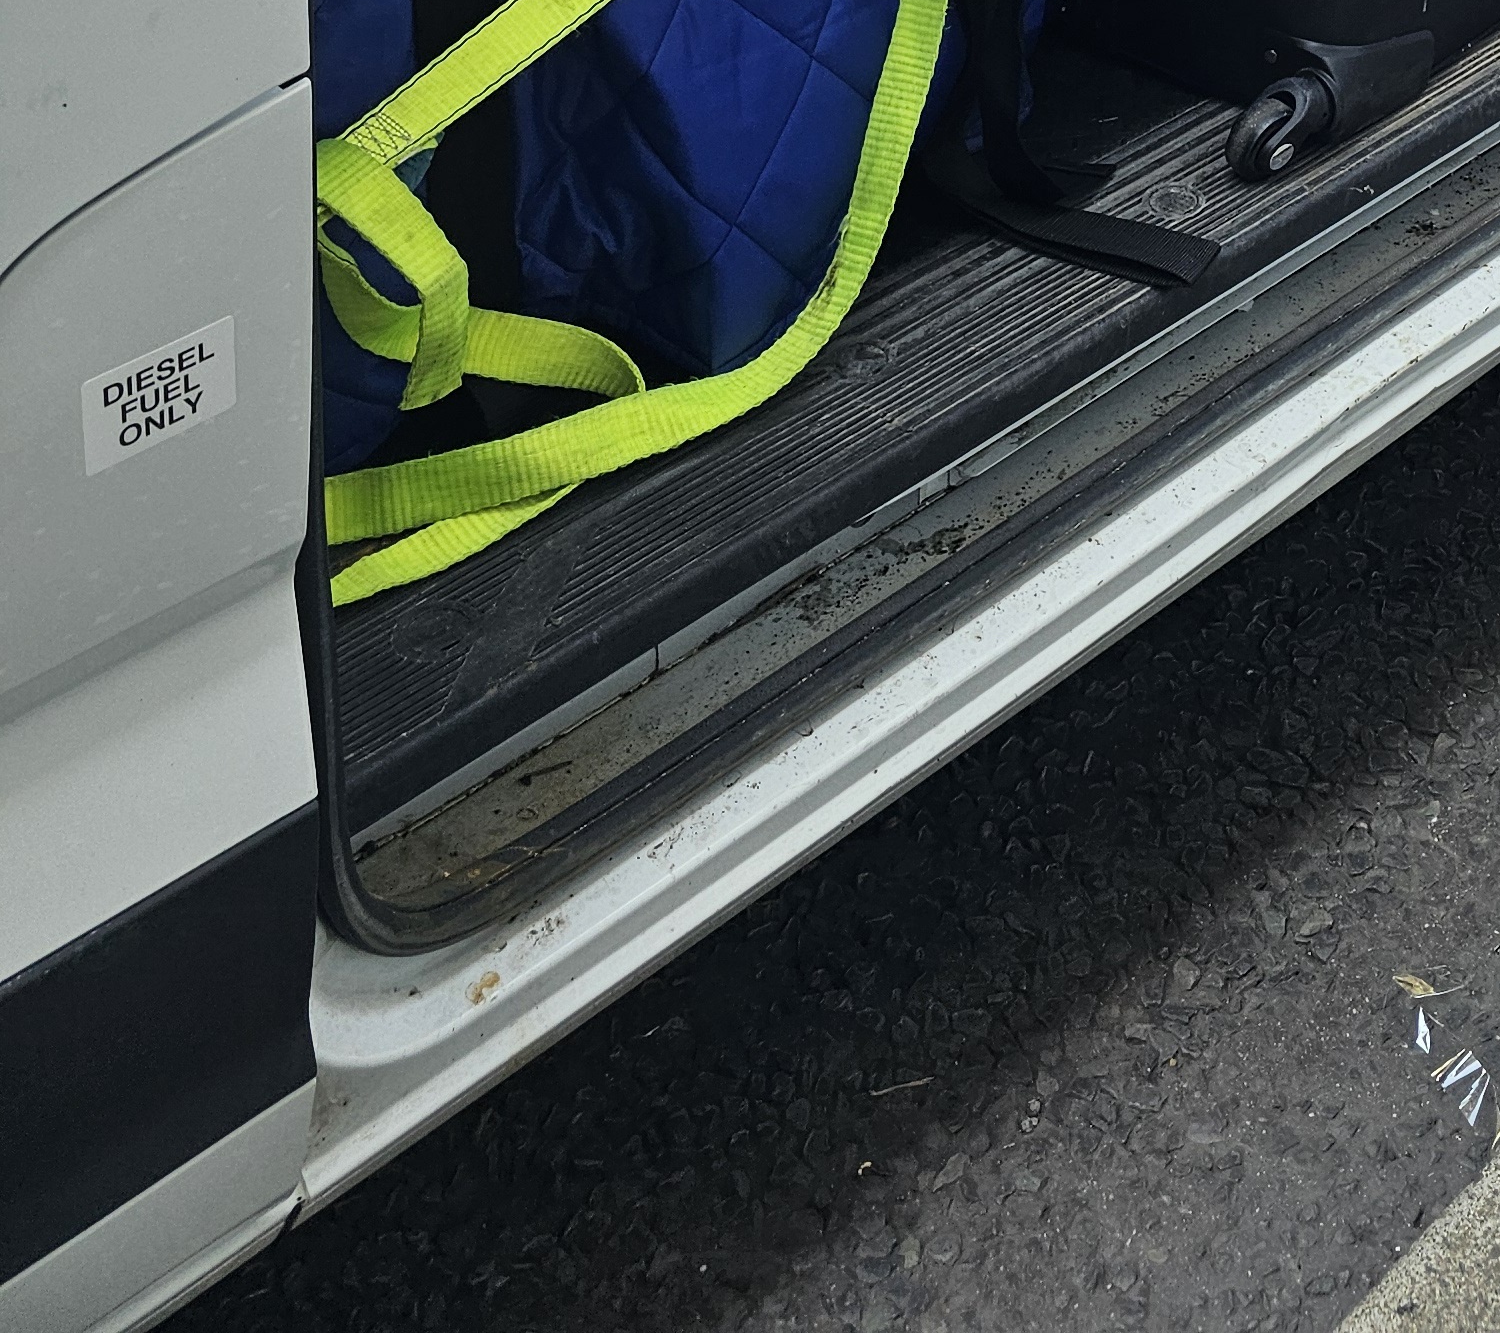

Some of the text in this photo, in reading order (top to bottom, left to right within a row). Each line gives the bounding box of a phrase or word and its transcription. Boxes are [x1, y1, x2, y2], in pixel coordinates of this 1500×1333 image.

[102, 342, 215, 408] DIESEL
[120, 373, 201, 424] FUEL
[119, 390, 204, 447] ONLY
